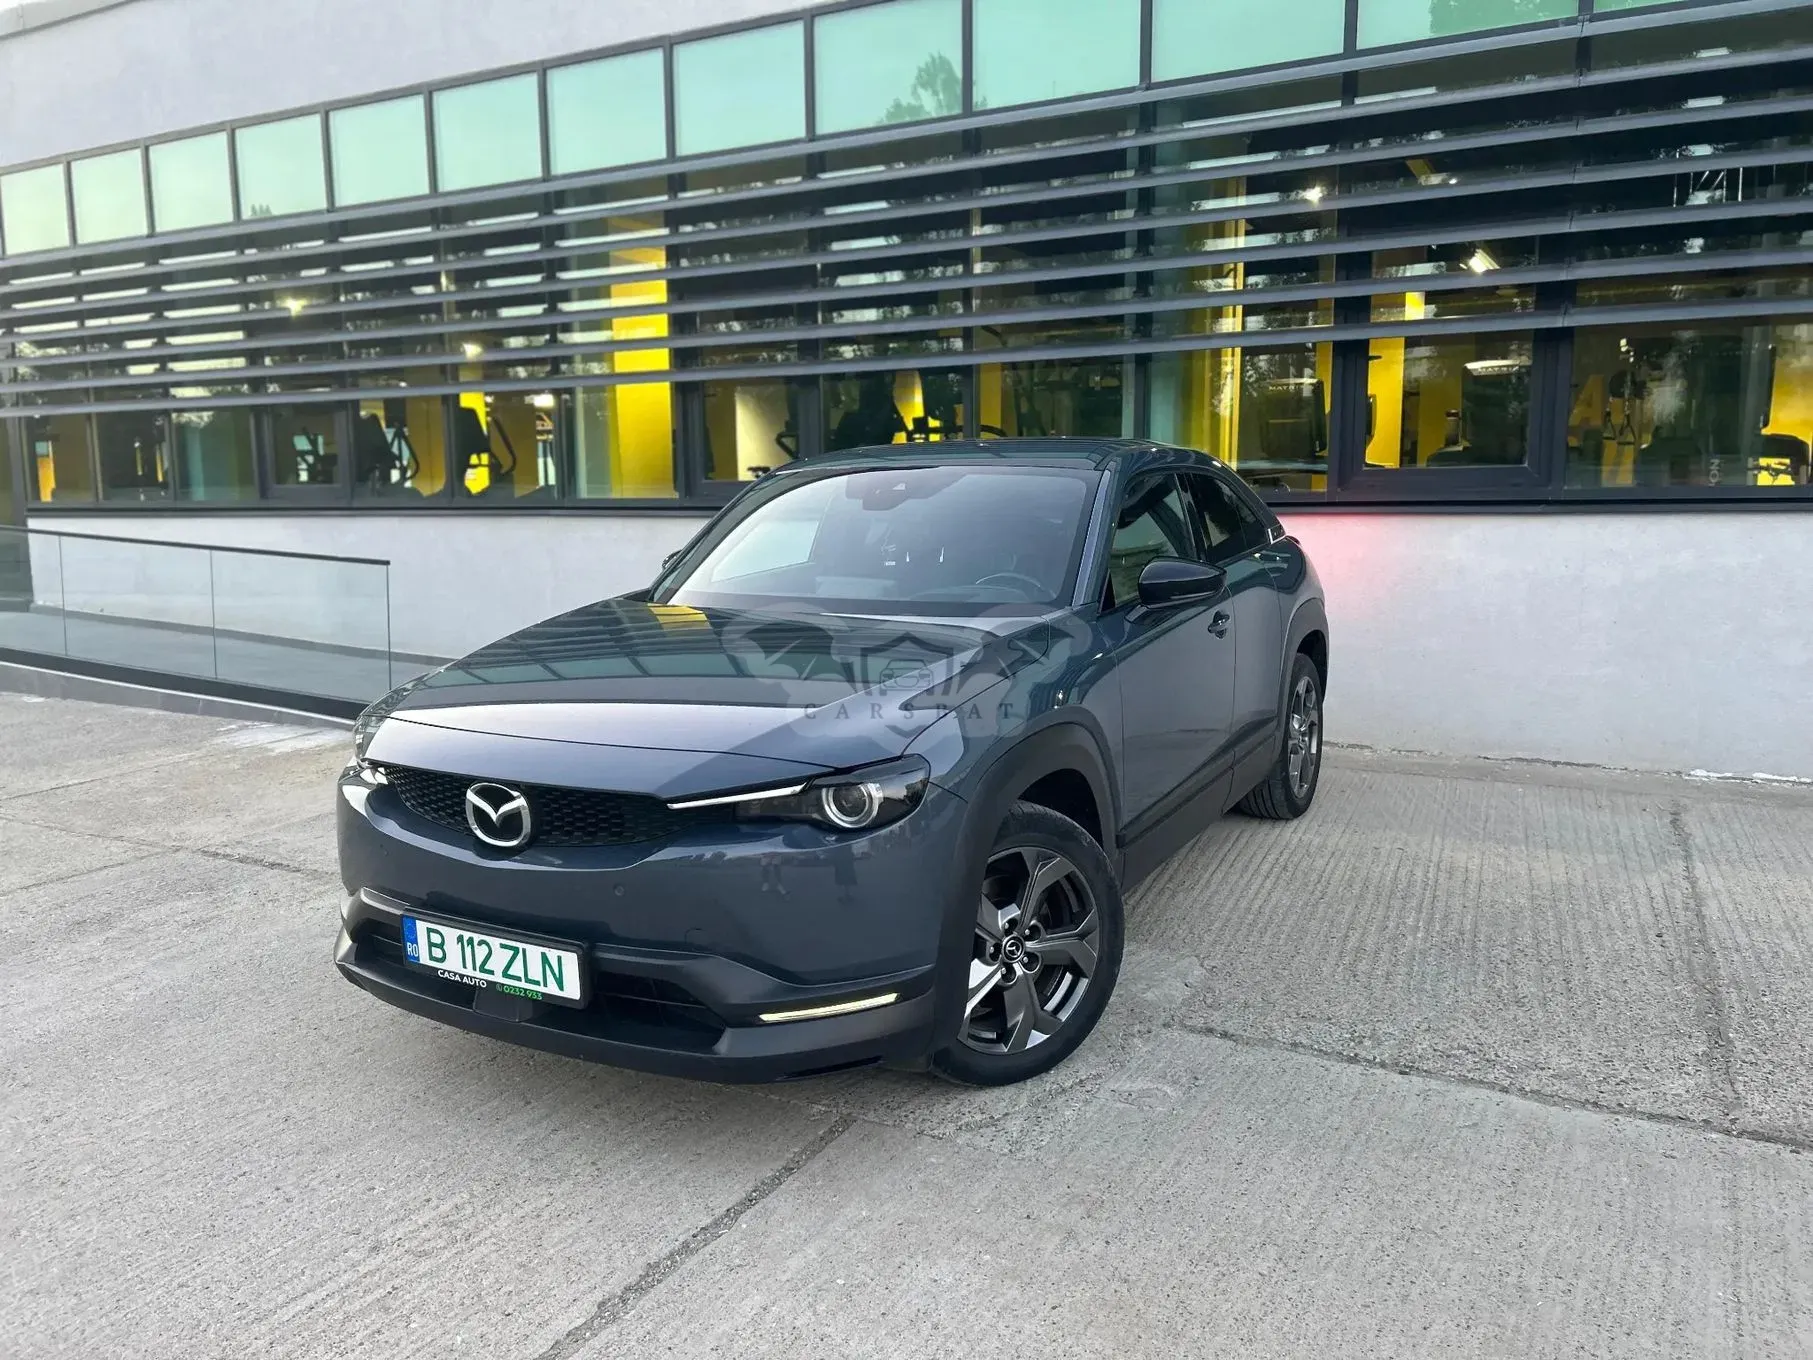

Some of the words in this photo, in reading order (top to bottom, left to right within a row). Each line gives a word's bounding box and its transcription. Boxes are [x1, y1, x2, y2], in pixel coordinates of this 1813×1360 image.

[406, 942, 419, 958] RO
[426, 926, 447, 964] B
[456, 933, 495, 976] 112
[499, 942, 565, 992] ZLN
[437, 969, 462, 983] CASA
[463, 975, 488, 988] AUTO
[503, 985, 526, 997] 0232
